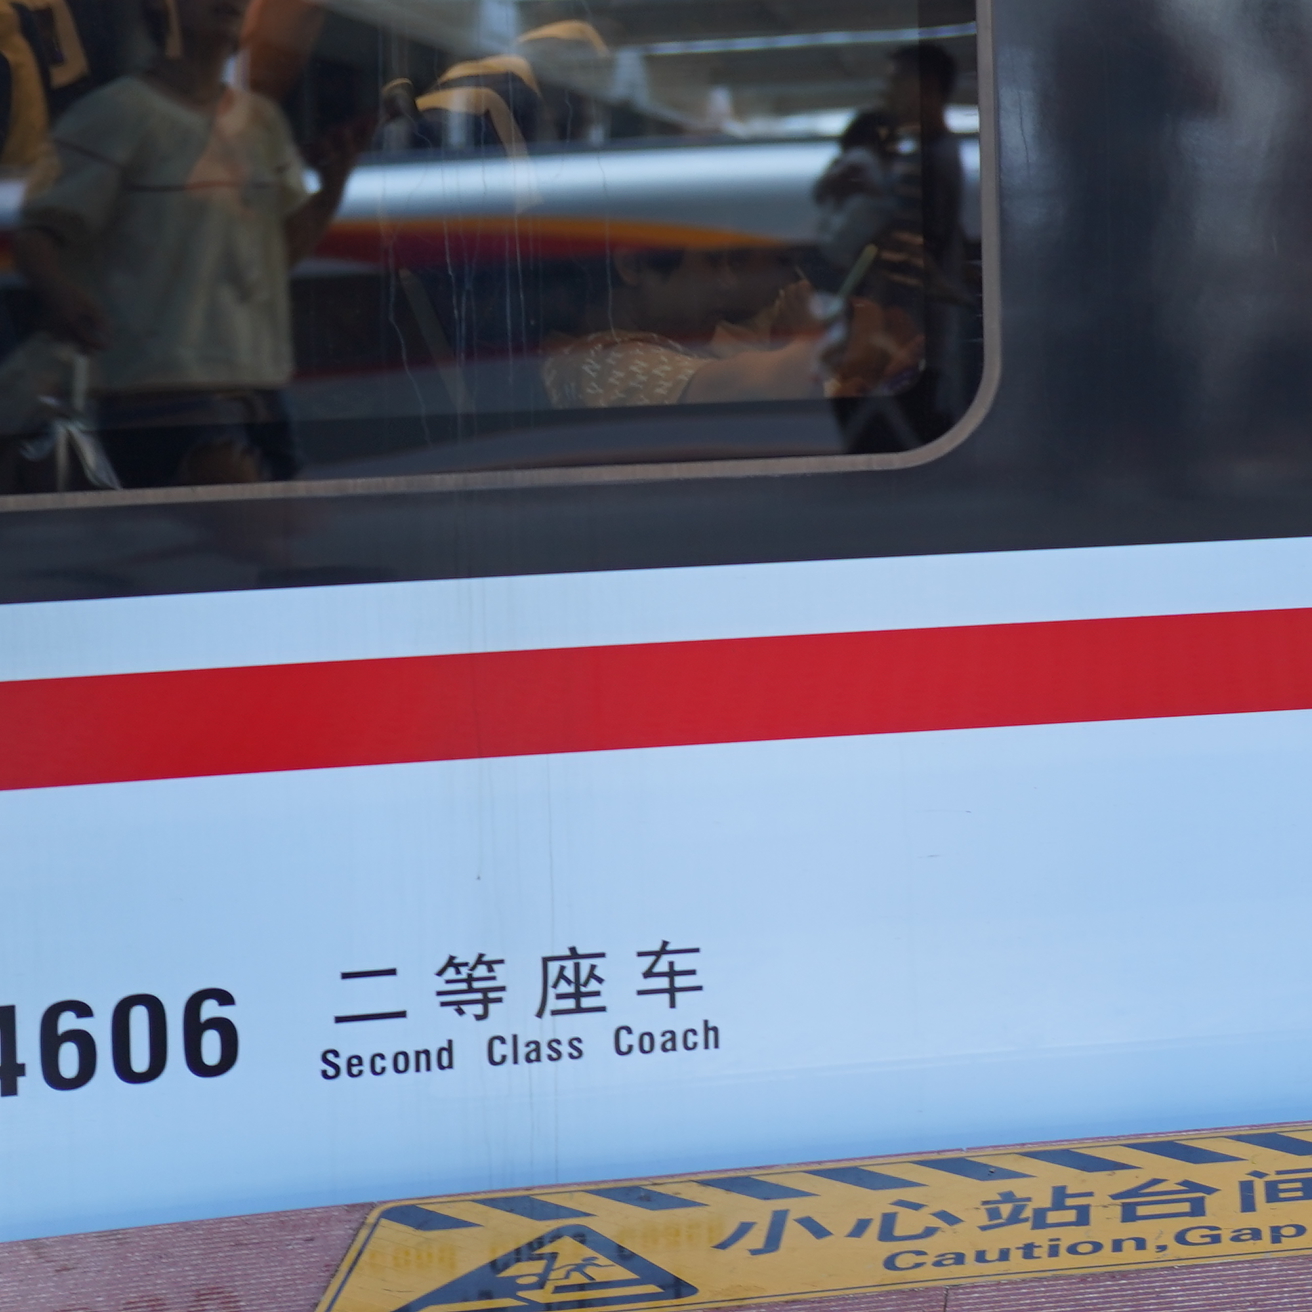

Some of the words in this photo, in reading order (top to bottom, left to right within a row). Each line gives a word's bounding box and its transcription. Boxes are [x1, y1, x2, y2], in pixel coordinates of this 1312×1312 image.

[333, 940, 704, 1024] 二等座车
[321, 1039, 455, 1081] Second
[487, 1030, 585, 1067] Class
[614, 1019, 720, 1057] Coach
